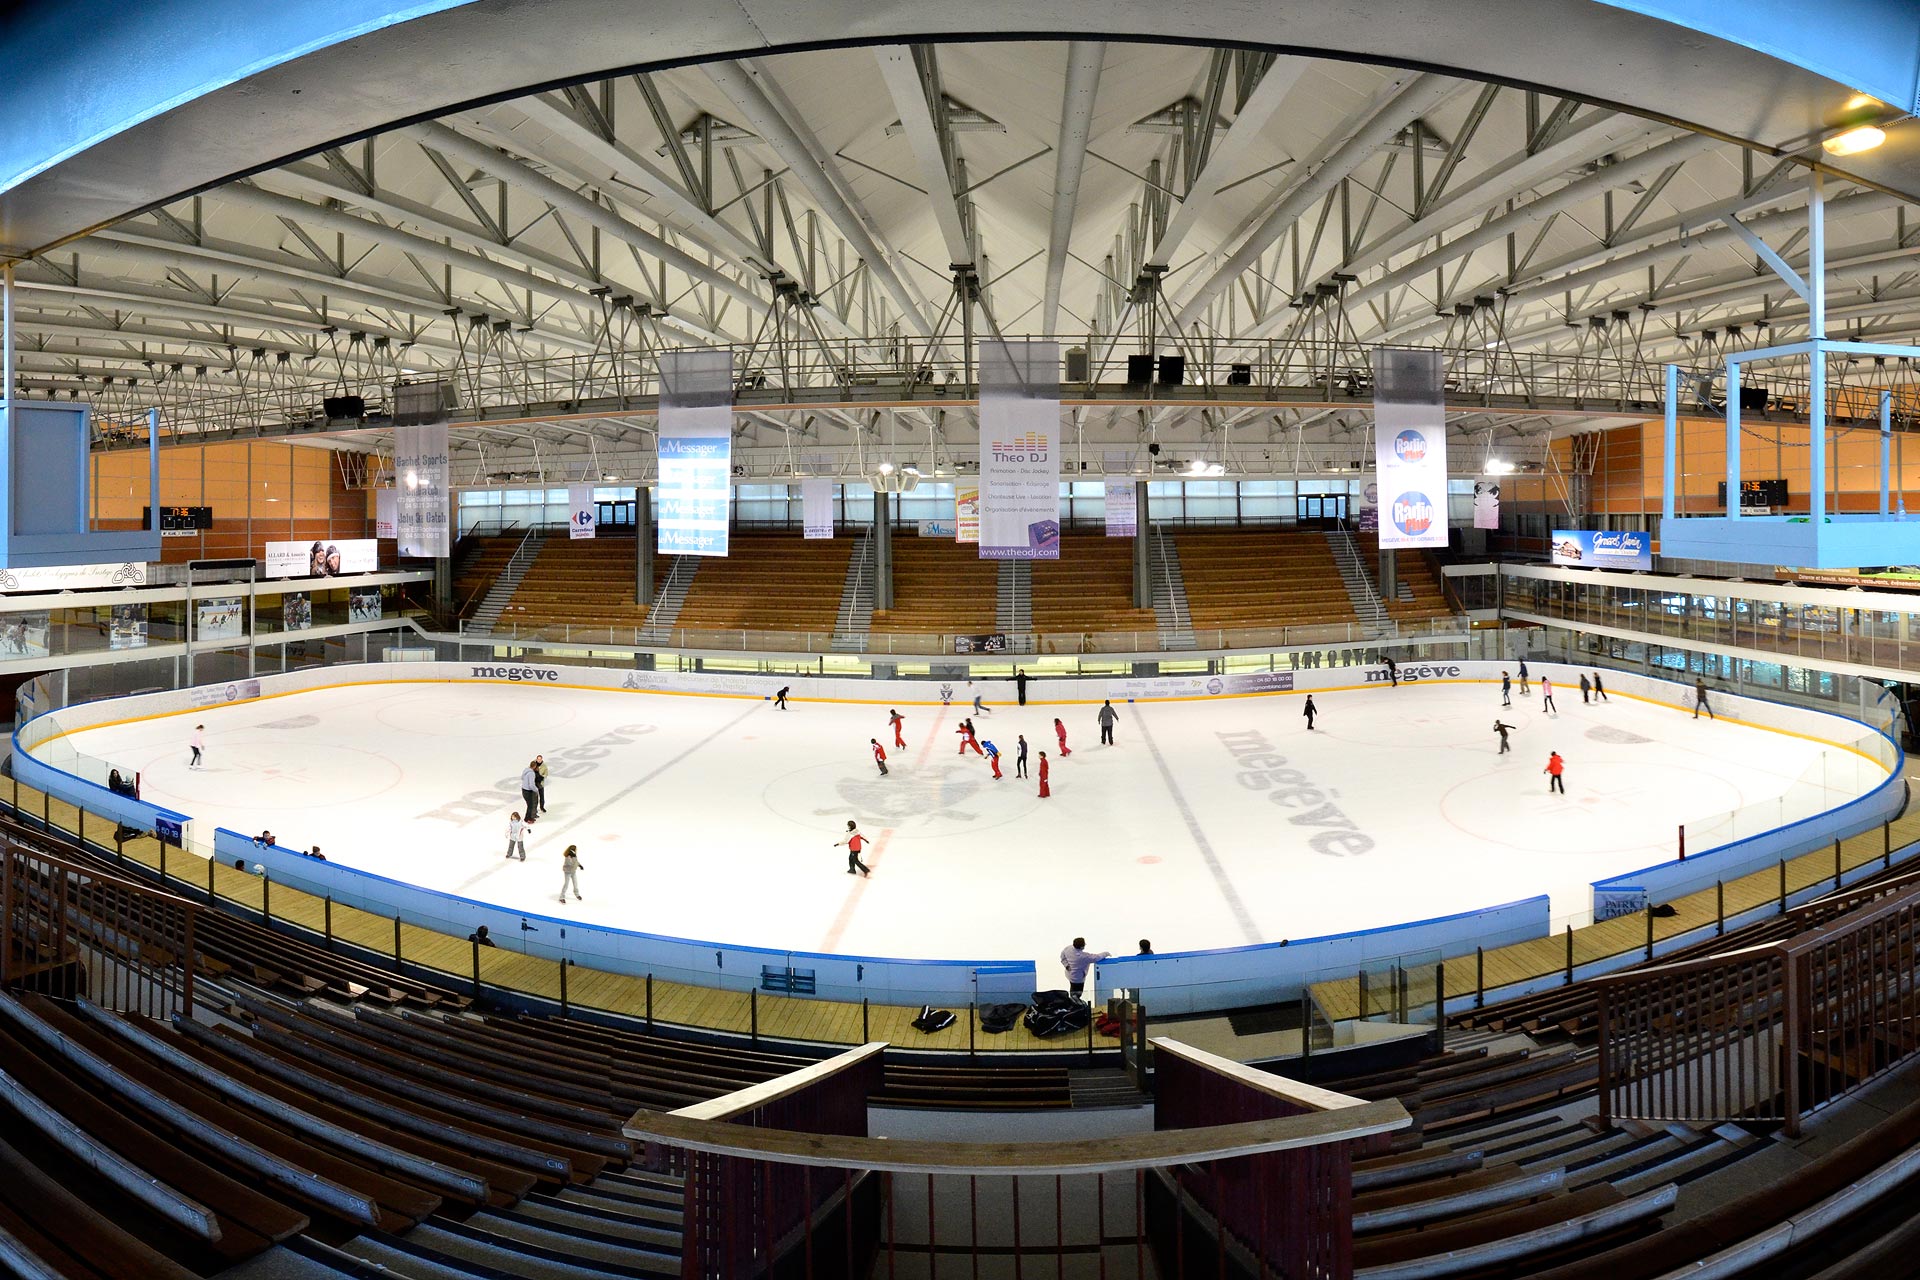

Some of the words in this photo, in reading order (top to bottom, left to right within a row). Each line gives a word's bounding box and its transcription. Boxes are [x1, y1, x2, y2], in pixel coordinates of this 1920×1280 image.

[1396, 438, 1426, 454] Radio
[422, 453, 447, 467] Sports
[992, 452, 1025, 463] Theo
[1030, 452, 1048, 463] DJ
[1394, 502, 1433, 523] Radio
[981, 548, 1058, 558] www.theodj.com
[471, 665, 559, 682] megève
[1364, 664, 1461, 683] megève
[413, 723, 657, 828] megève
[1214, 729, 1376, 858] megève
[546, 1159, 564, 1170] C10
